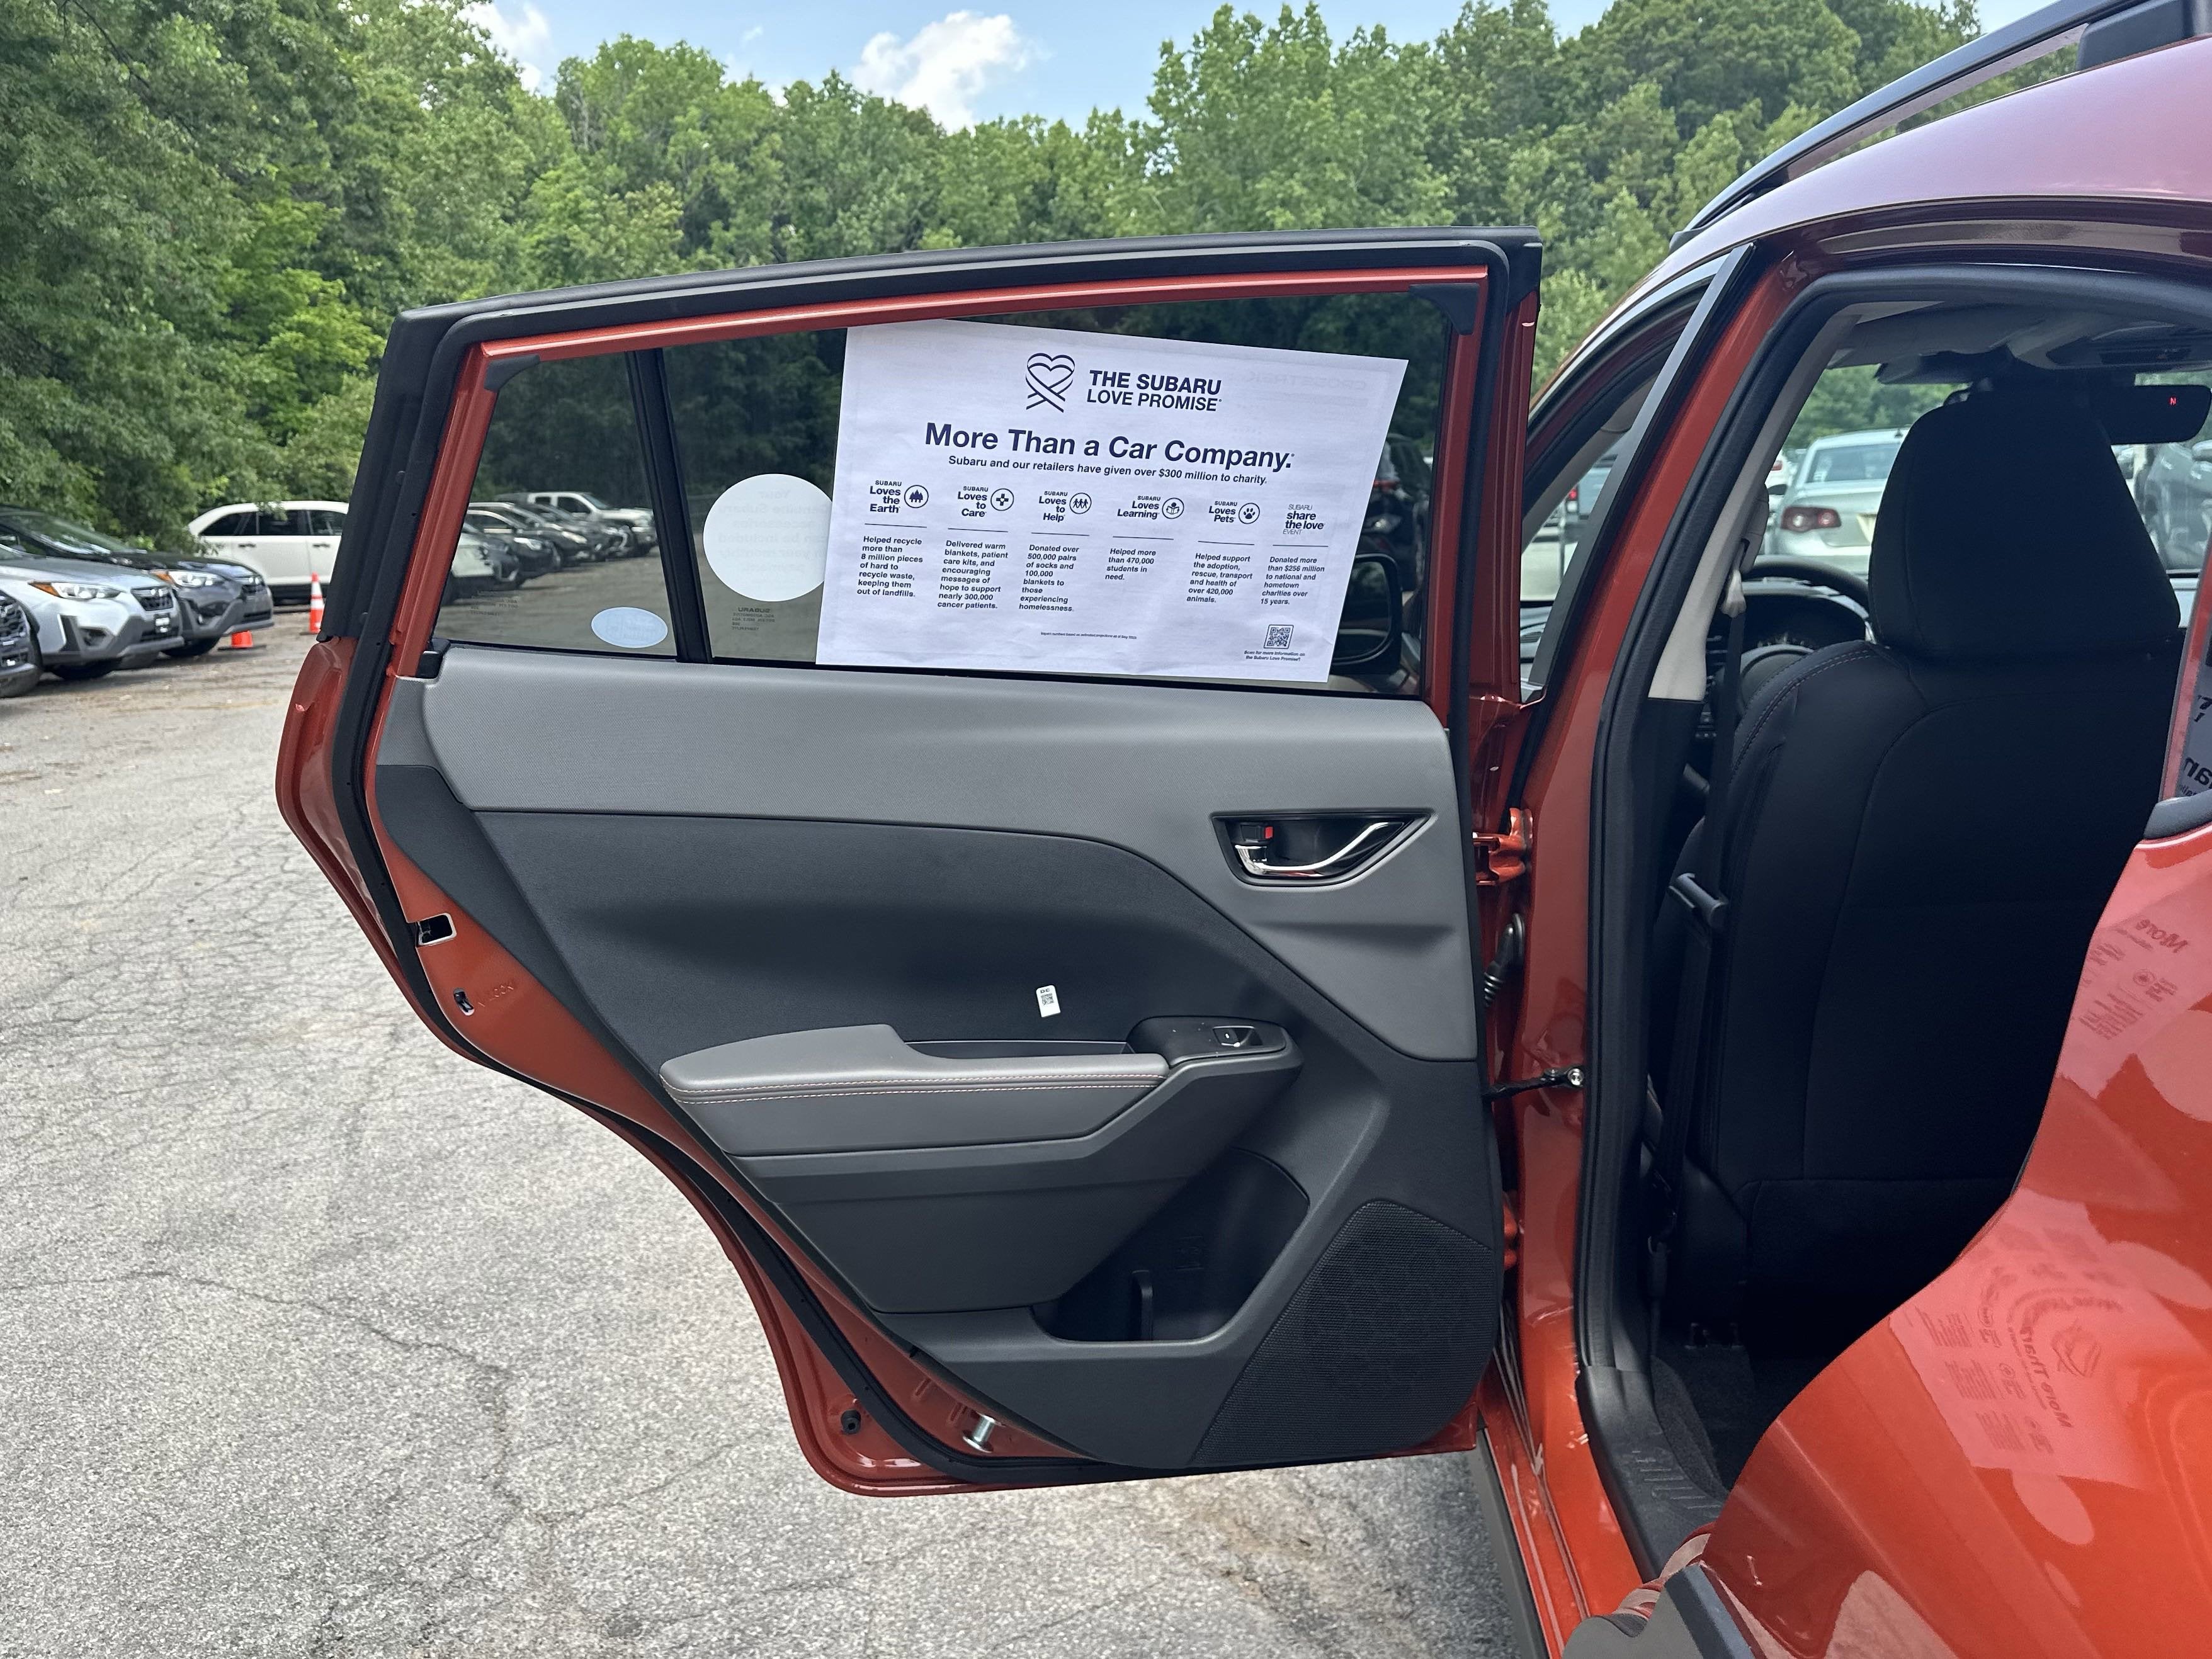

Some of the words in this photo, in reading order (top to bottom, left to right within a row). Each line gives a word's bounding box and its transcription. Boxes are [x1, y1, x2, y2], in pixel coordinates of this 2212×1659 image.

[1089, 370, 1131, 388] THE
[1137, 374, 1222, 395] SUBARU
[1087, 389, 1133, 405] LOVE
[926, 422, 999, 450] More
[1009, 429, 1075, 455] Than
[1084, 440, 1099, 456] a
[1109, 436, 1157, 461] Car
[948, 456, 987, 467] Subaru
[990, 460, 1010, 468] and
[1033, 462, 1074, 472] retailers
[1077, 463, 1101, 473] have
[1104, 466, 1132, 476] given
[1159, 468, 1182, 478] $300
[1185, 471, 1218, 481] million
[1221, 473, 1230, 482] to
[1233, 474, 1267, 485] charity.
[870, 486, 901, 496] Loves
[883, 495, 900, 504] the
[958, 491, 987, 501] Loves
[1039, 496, 1067, 505] Loves
[870, 504, 899, 514] Earth
[976, 501, 986, 509] to
[1132, 501, 1159, 510] Loves
[961, 508, 985, 518] Care
[1117, 508, 1158, 520] Learning
[1209, 506, 1236, 514] Loves
[1043, 512, 1064, 523] Help
[1214, 514, 1235, 523] Pets
[1286, 511, 1317, 520] share
[1285, 521, 1303, 529] the
[1303, 521, 1324, 529] love
[863, 536, 892, 545] Helped
[946, 540, 983, 548] Delivered
[944, 549, 980, 558] blankets,
[1110, 548, 1136, 557] Helped
[1195, 553, 1222, 562] Helped
[963, 558, 978, 567] kits,
[1207, 563, 1240, 571] adoption,
[942, 568, 990, 577] encouraging
[1026, 570, 1053, 578] 100,000
[1220, 572, 1253, 580] transport
[858, 579, 890, 589] keeping
[940, 584, 960, 592] hope
[939, 593, 963, 601] nearly
[1021, 596, 1069, 604] experiencing
[1019, 603, 1074, 611] homelessness.
